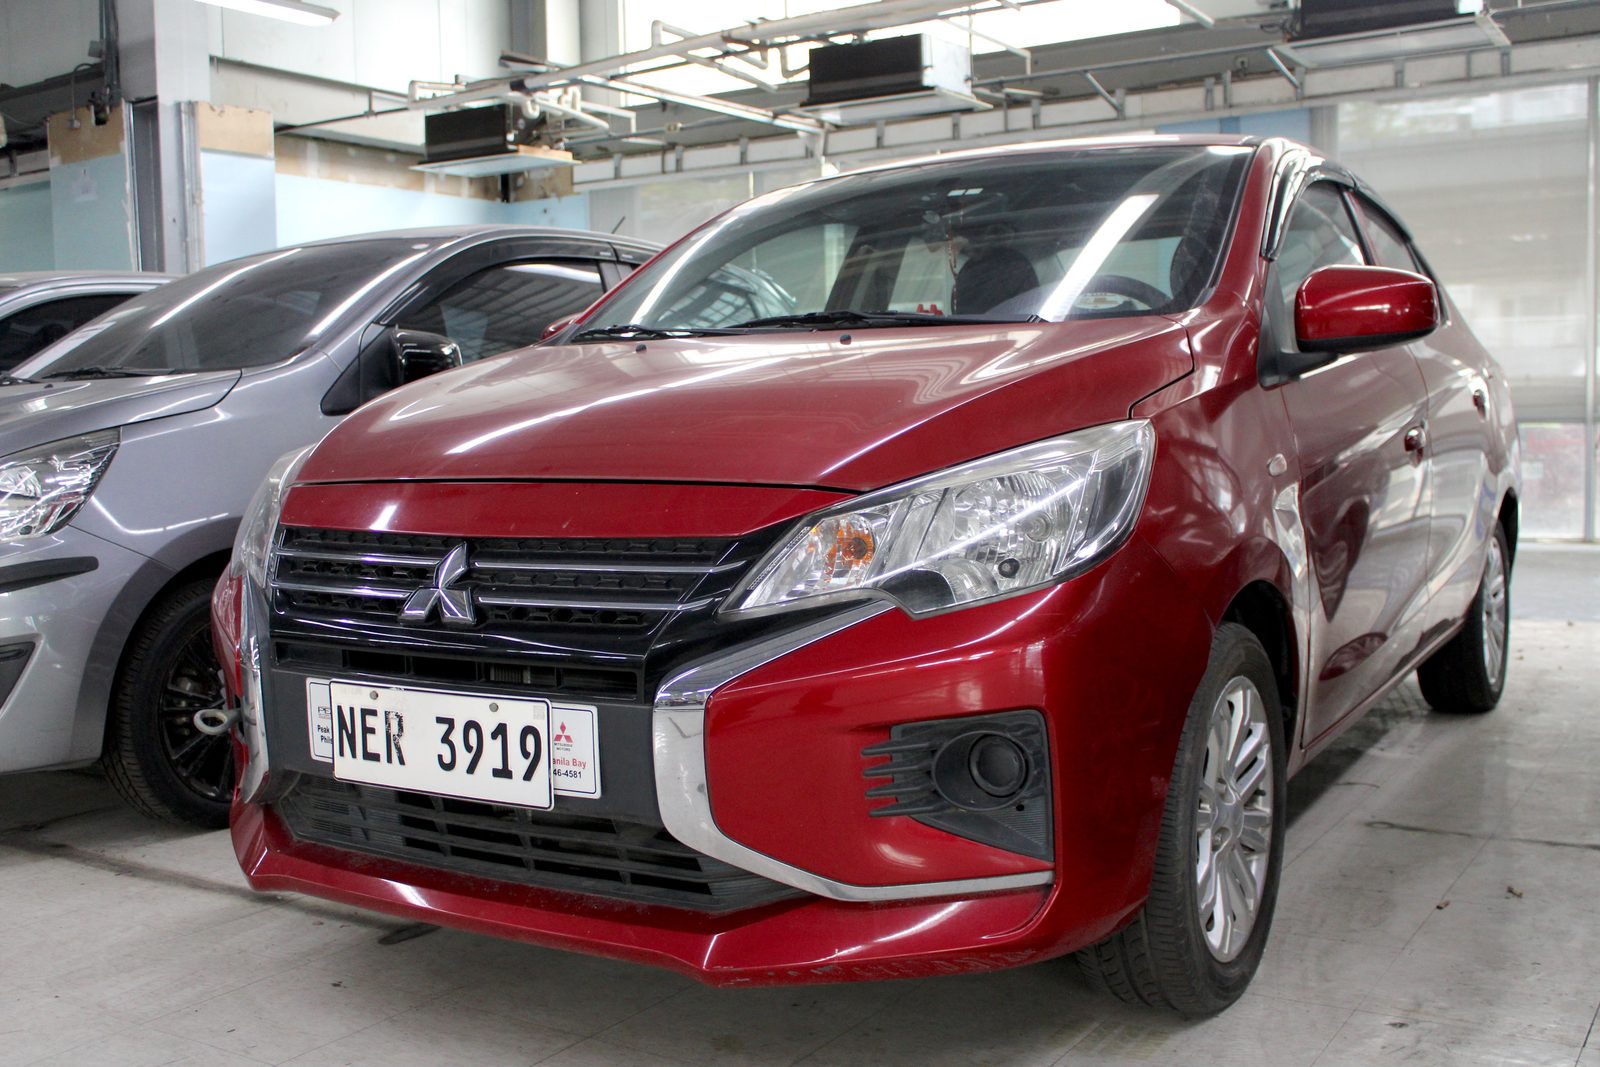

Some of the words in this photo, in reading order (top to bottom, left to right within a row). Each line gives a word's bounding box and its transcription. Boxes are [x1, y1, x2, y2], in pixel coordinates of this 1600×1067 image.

[337, 705, 405, 766] NER
[435, 716, 542, 782] 3919
[553, 758, 570, 766] anila
[572, 758, 586, 769] Bay
[553, 768, 581, 778] 46-4581
